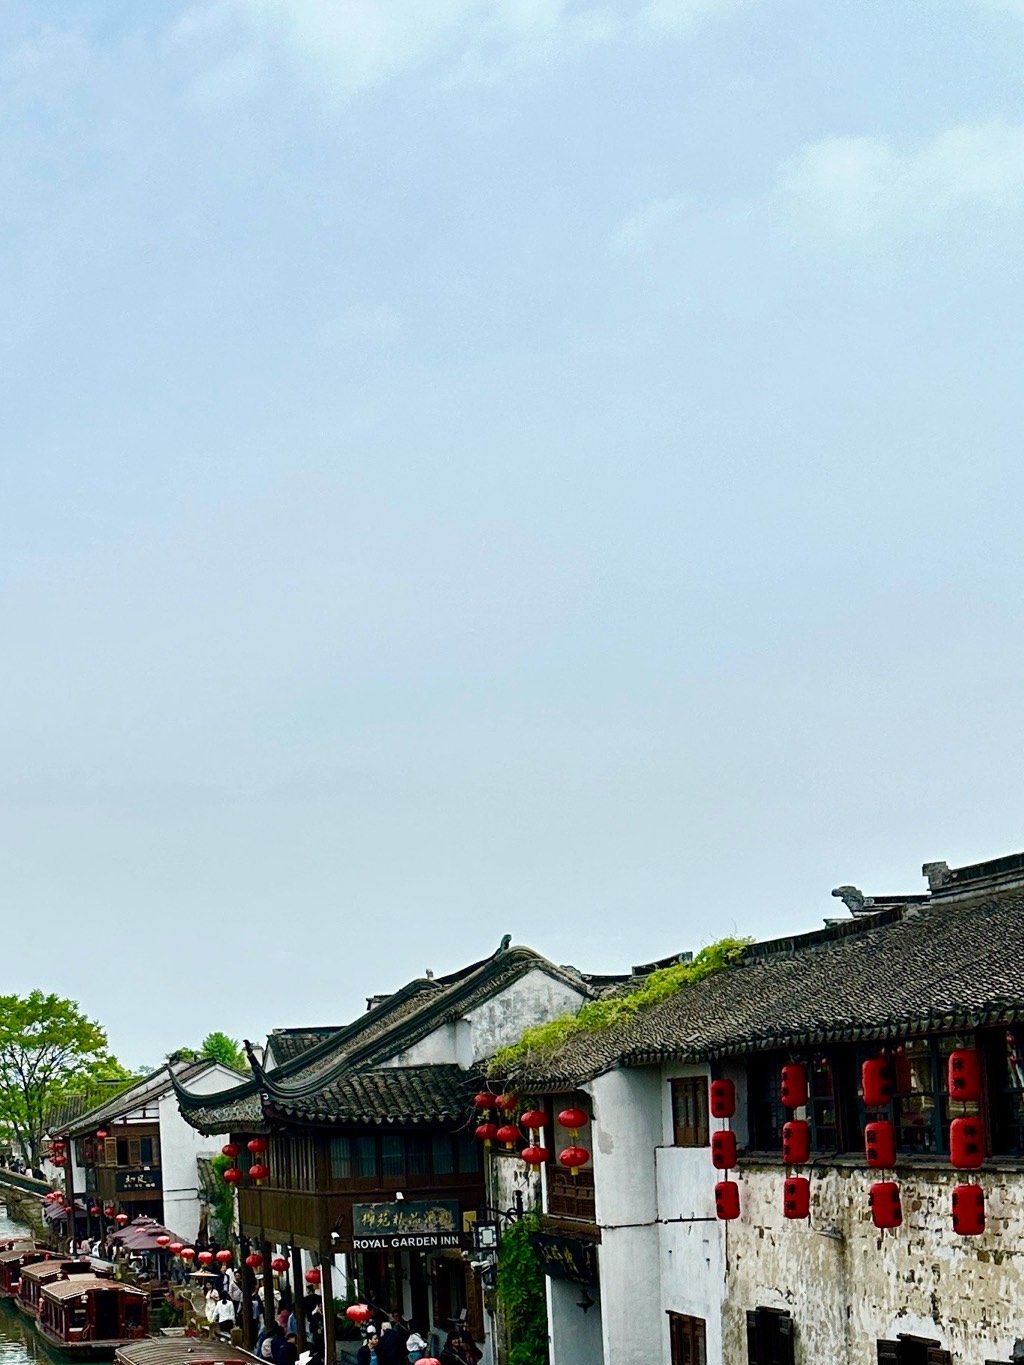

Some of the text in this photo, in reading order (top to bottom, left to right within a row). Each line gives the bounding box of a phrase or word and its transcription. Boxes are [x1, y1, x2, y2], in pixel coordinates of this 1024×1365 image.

[353, 1236, 459, 1249] ROYAL GARDEN INN
